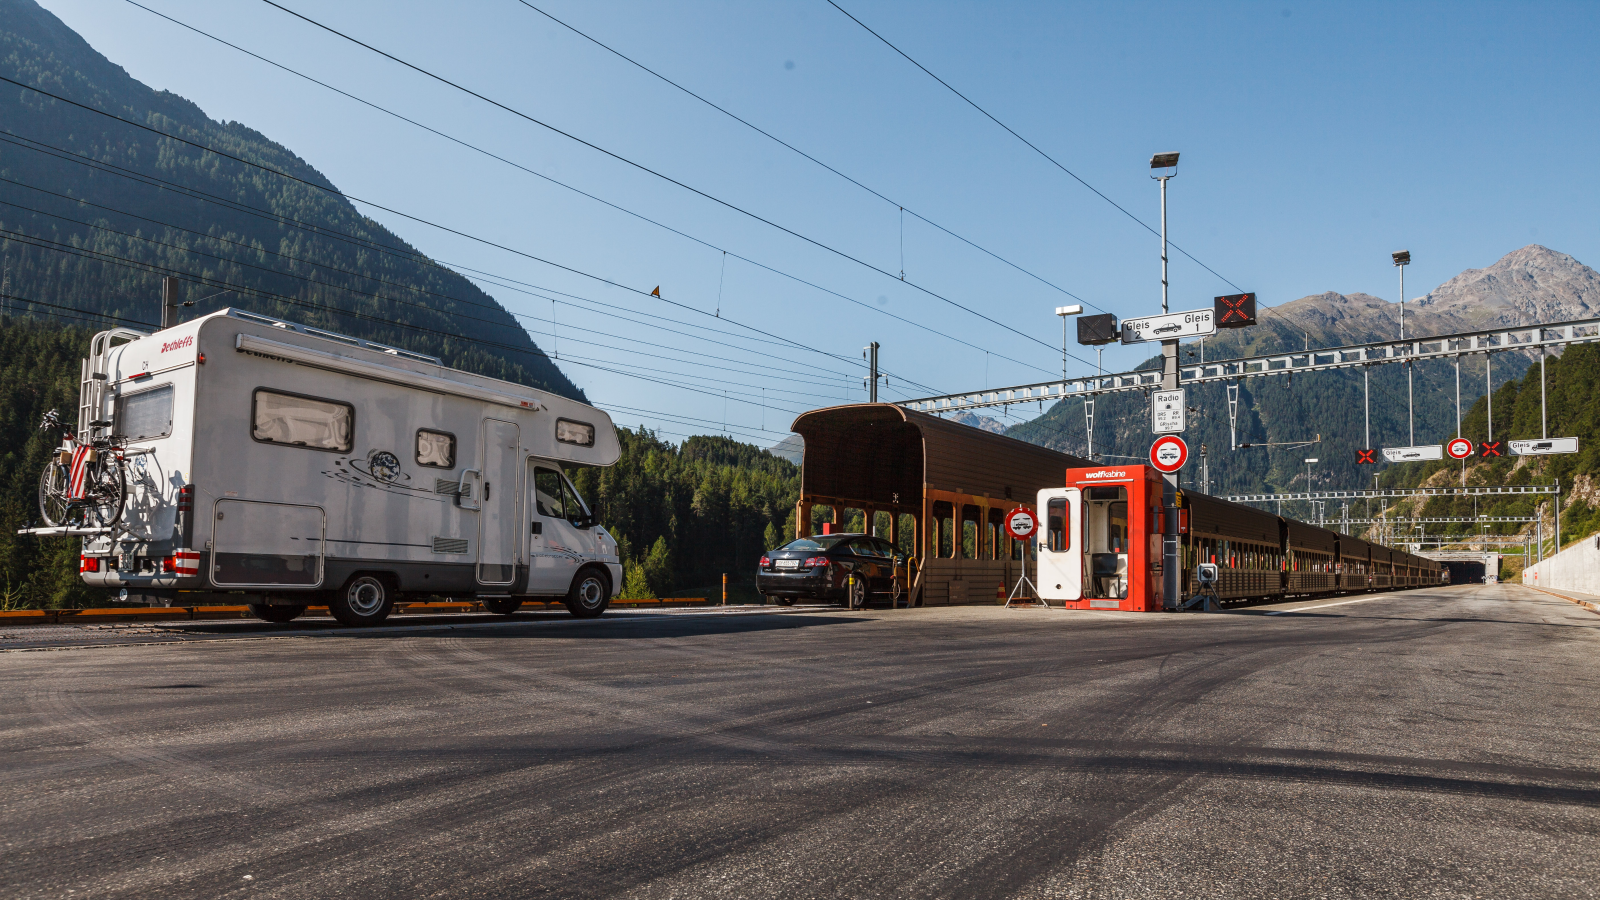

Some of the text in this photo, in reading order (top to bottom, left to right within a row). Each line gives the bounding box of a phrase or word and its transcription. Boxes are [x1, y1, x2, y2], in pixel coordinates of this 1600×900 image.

[1184, 313, 1210, 324] Gleis
[1126, 321, 1150, 331] Gleis
[1134, 331, 1141, 340] 2
[161, 335, 194, 354] Dethleffs
[1085, 470, 1126, 479] wolfkabine
